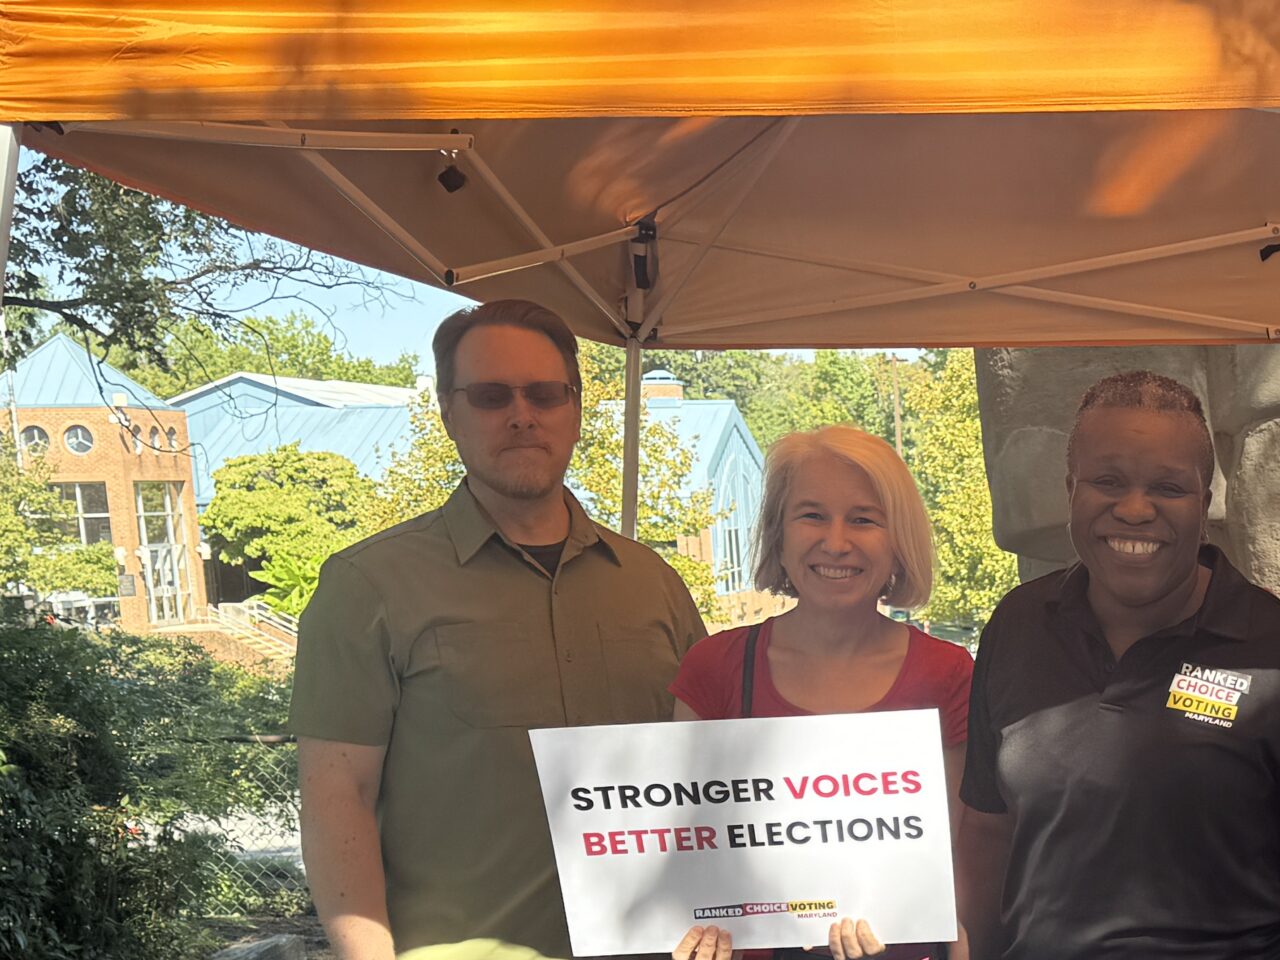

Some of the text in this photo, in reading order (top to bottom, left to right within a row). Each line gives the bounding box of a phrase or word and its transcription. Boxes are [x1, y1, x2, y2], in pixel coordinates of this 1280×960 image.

[1181, 662, 1248, 690] RANKED
[1176, 678, 1235, 702] CHOICE
[1172, 694, 1233, 718] VOTING
[1185, 711, 1233, 728] MARYLAND
[570, 770, 923, 812] STRONGER VOICES
[582, 815, 924, 857] BETTER ELECTIONS
[695, 901, 834, 918] RANKED CHOICE VOTING
